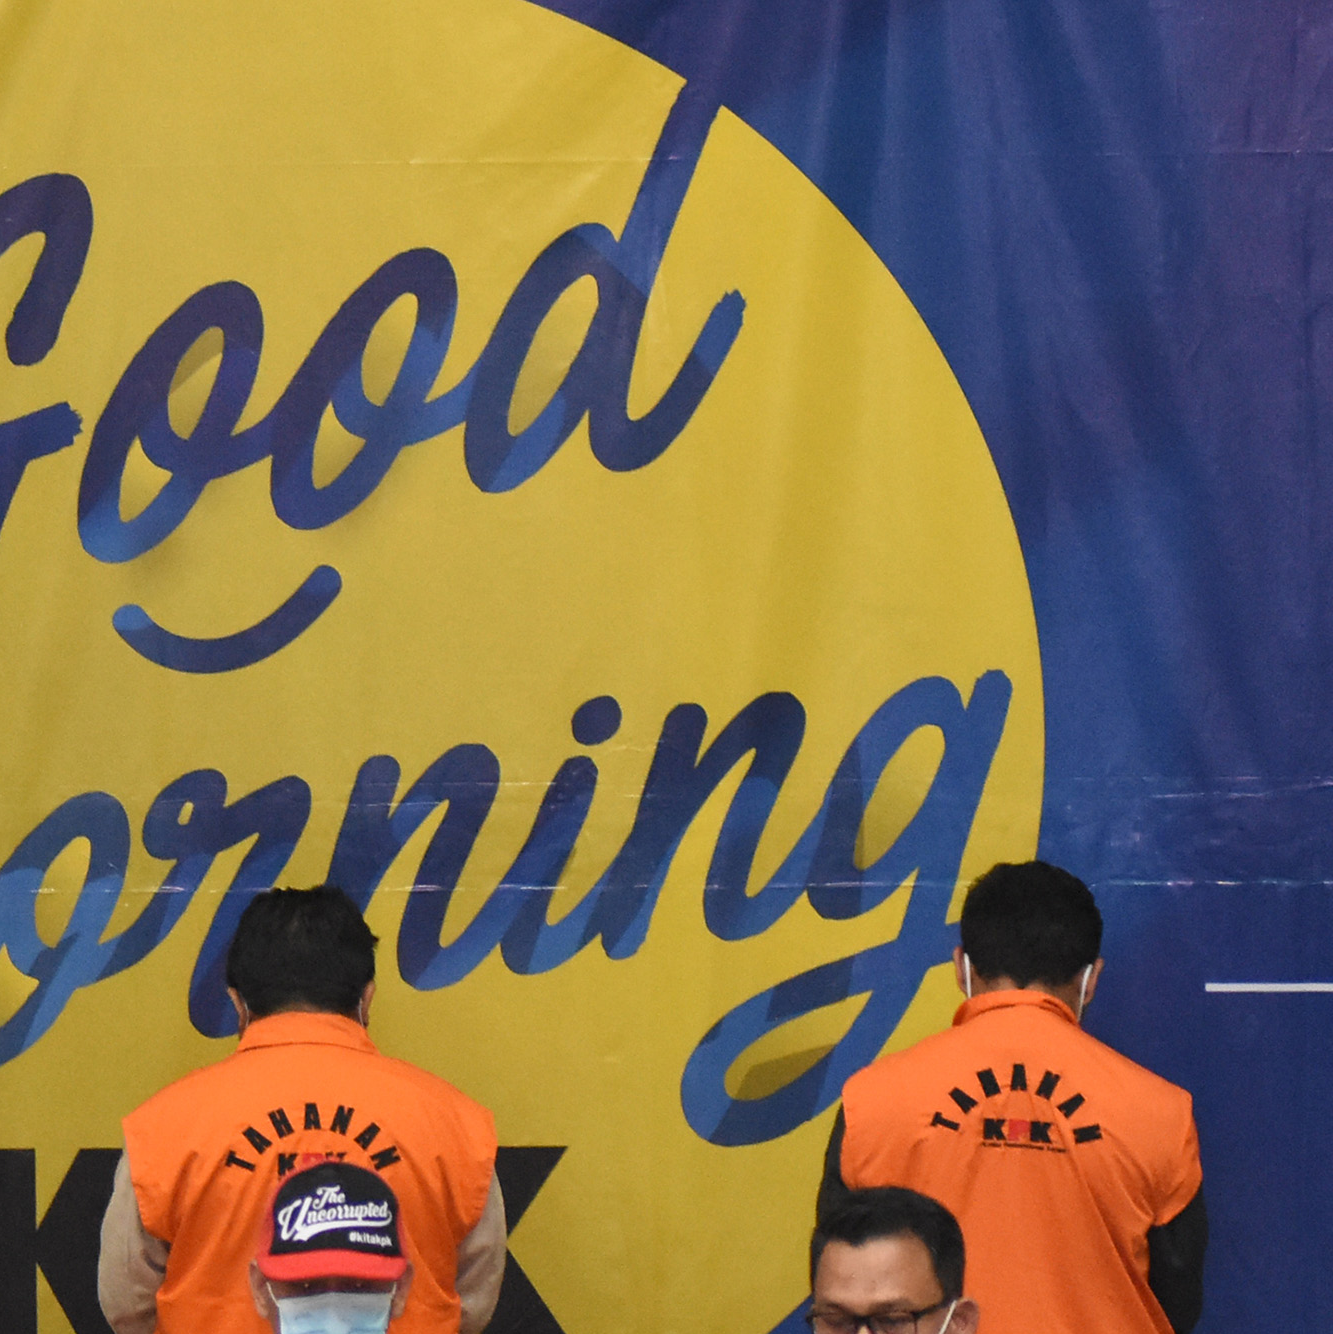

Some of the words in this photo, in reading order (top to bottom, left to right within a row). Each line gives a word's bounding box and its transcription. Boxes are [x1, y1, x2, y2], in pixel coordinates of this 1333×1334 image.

[931, 1063, 1103, 1145] TAHANAN
[225, 1103, 402, 1172] TAHANAN
[983, 1118, 1052, 1144] KPK
[277, 1196, 392, 1241] Uncorrupted
[313, 1184, 346, 1209] The
